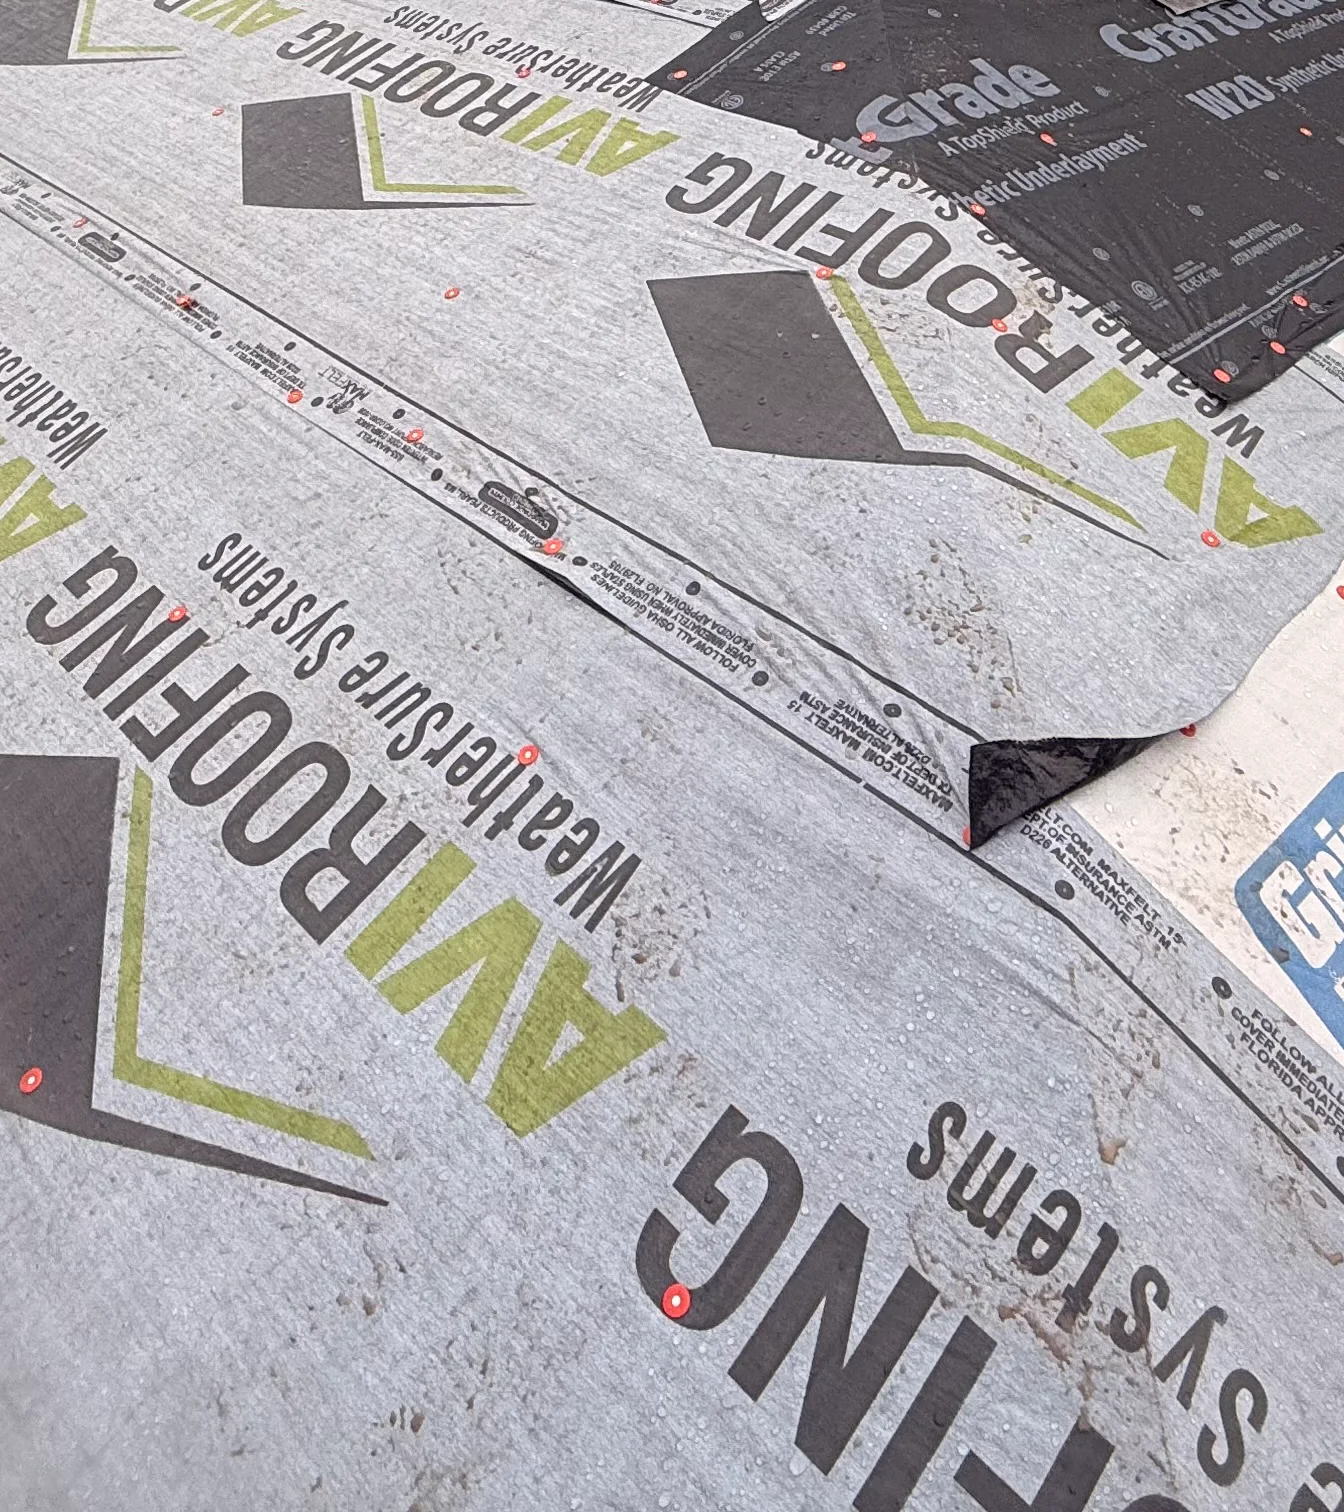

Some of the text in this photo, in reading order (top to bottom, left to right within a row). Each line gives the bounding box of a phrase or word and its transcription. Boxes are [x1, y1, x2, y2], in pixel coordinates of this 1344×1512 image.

[383, 5, 664, 113] WeatherSure Systems
[1027, 100, 1090, 134] Product
[1186, 75, 1276, 122] W20
[1016, 132, 1149, 193] Underlayment
[479, 503, 521, 533] PRODUCTS
[608, 560, 646, 587] FL29705
[589, 562, 757, 669] COVER IMMEDIATELY WHEN USING STAPLES
[590, 573, 740, 673] FOLLOW ALL OSHA GUIDELINES
[662, 590, 713, 626] APPROVAL
[710, 620, 755, 653] FLORIDA
[196, 532, 642, 934] WeatherSure Systems
[799, 690, 832, 715] ASTM
[804, 704, 862, 752] MAXFELT
[827, 704, 893, 755] INSURANCE
[833, 698, 906, 750] ALTERNATIVE
[861, 740, 954, 813] MAXFELT.COM
[1019, 818, 1132, 927] D226 ALTERNATIVE
[1064, 842, 1172, 952] INSURANCE ASTM
[1096, 858, 1162, 922] MAXFELT
[1230, 1006, 1283, 1054] COVER
[1246, 1008, 1317, 1075] FOLLOW
[1239, 1031, 1312, 1100] FLORIDA
[906, 1099, 1269, 1486] Systems
